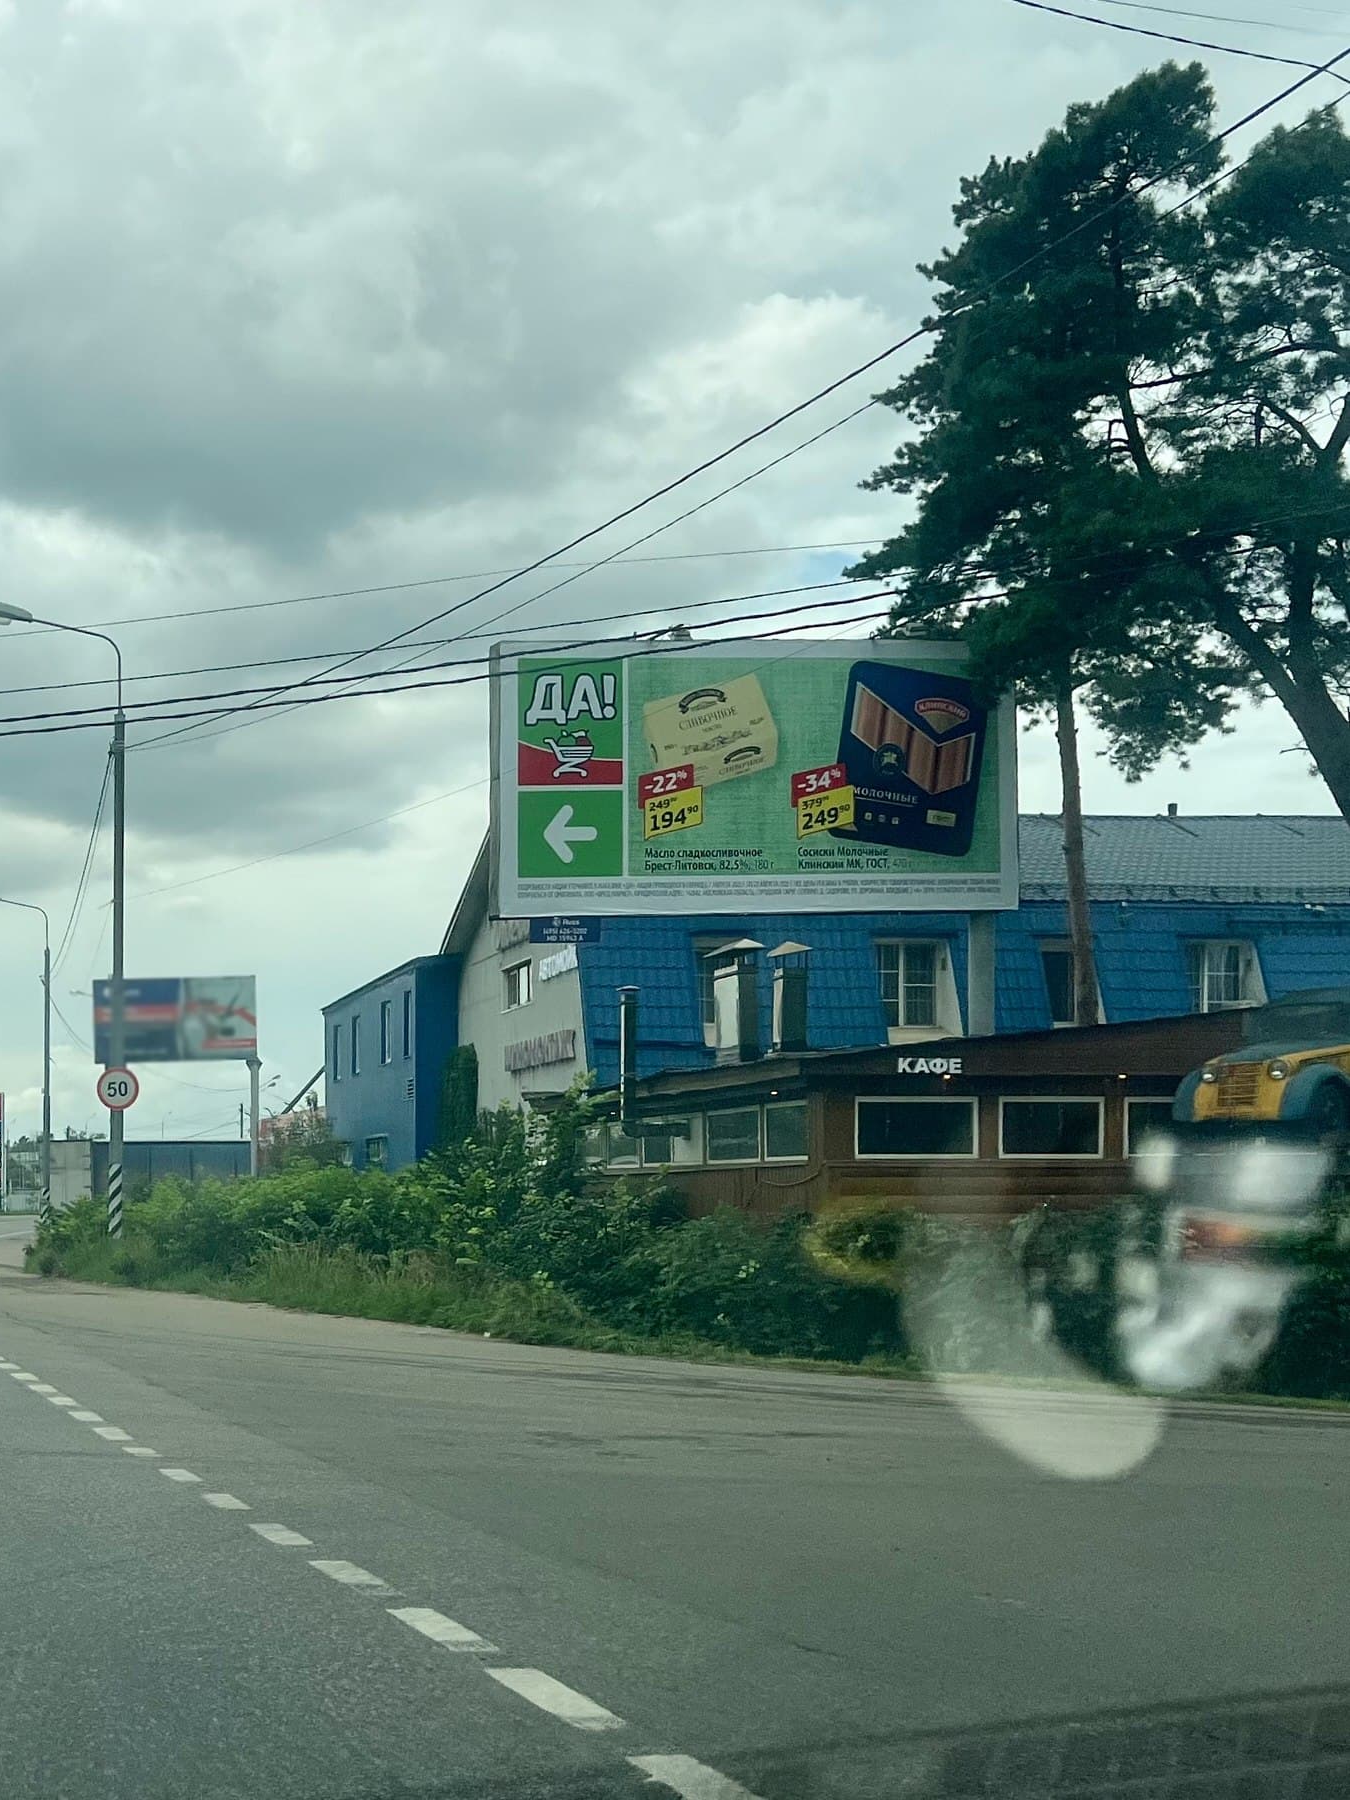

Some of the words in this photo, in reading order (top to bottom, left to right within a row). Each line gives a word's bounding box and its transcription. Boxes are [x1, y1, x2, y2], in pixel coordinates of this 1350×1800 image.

[525, 673, 617, 726] ДА!
[644, 769, 688, 794] -22%
[797, 767, 841, 793] -34%
[644, 848, 675, 859] Масло
[677, 849, 763, 862] сладкосливочное
[797, 847, 835, 858] Сосиски
[837, 846, 889, 857] Молочные
[897, 1057, 962, 1074] КАФЕ
[107, 1081, 128, 1098] 50
